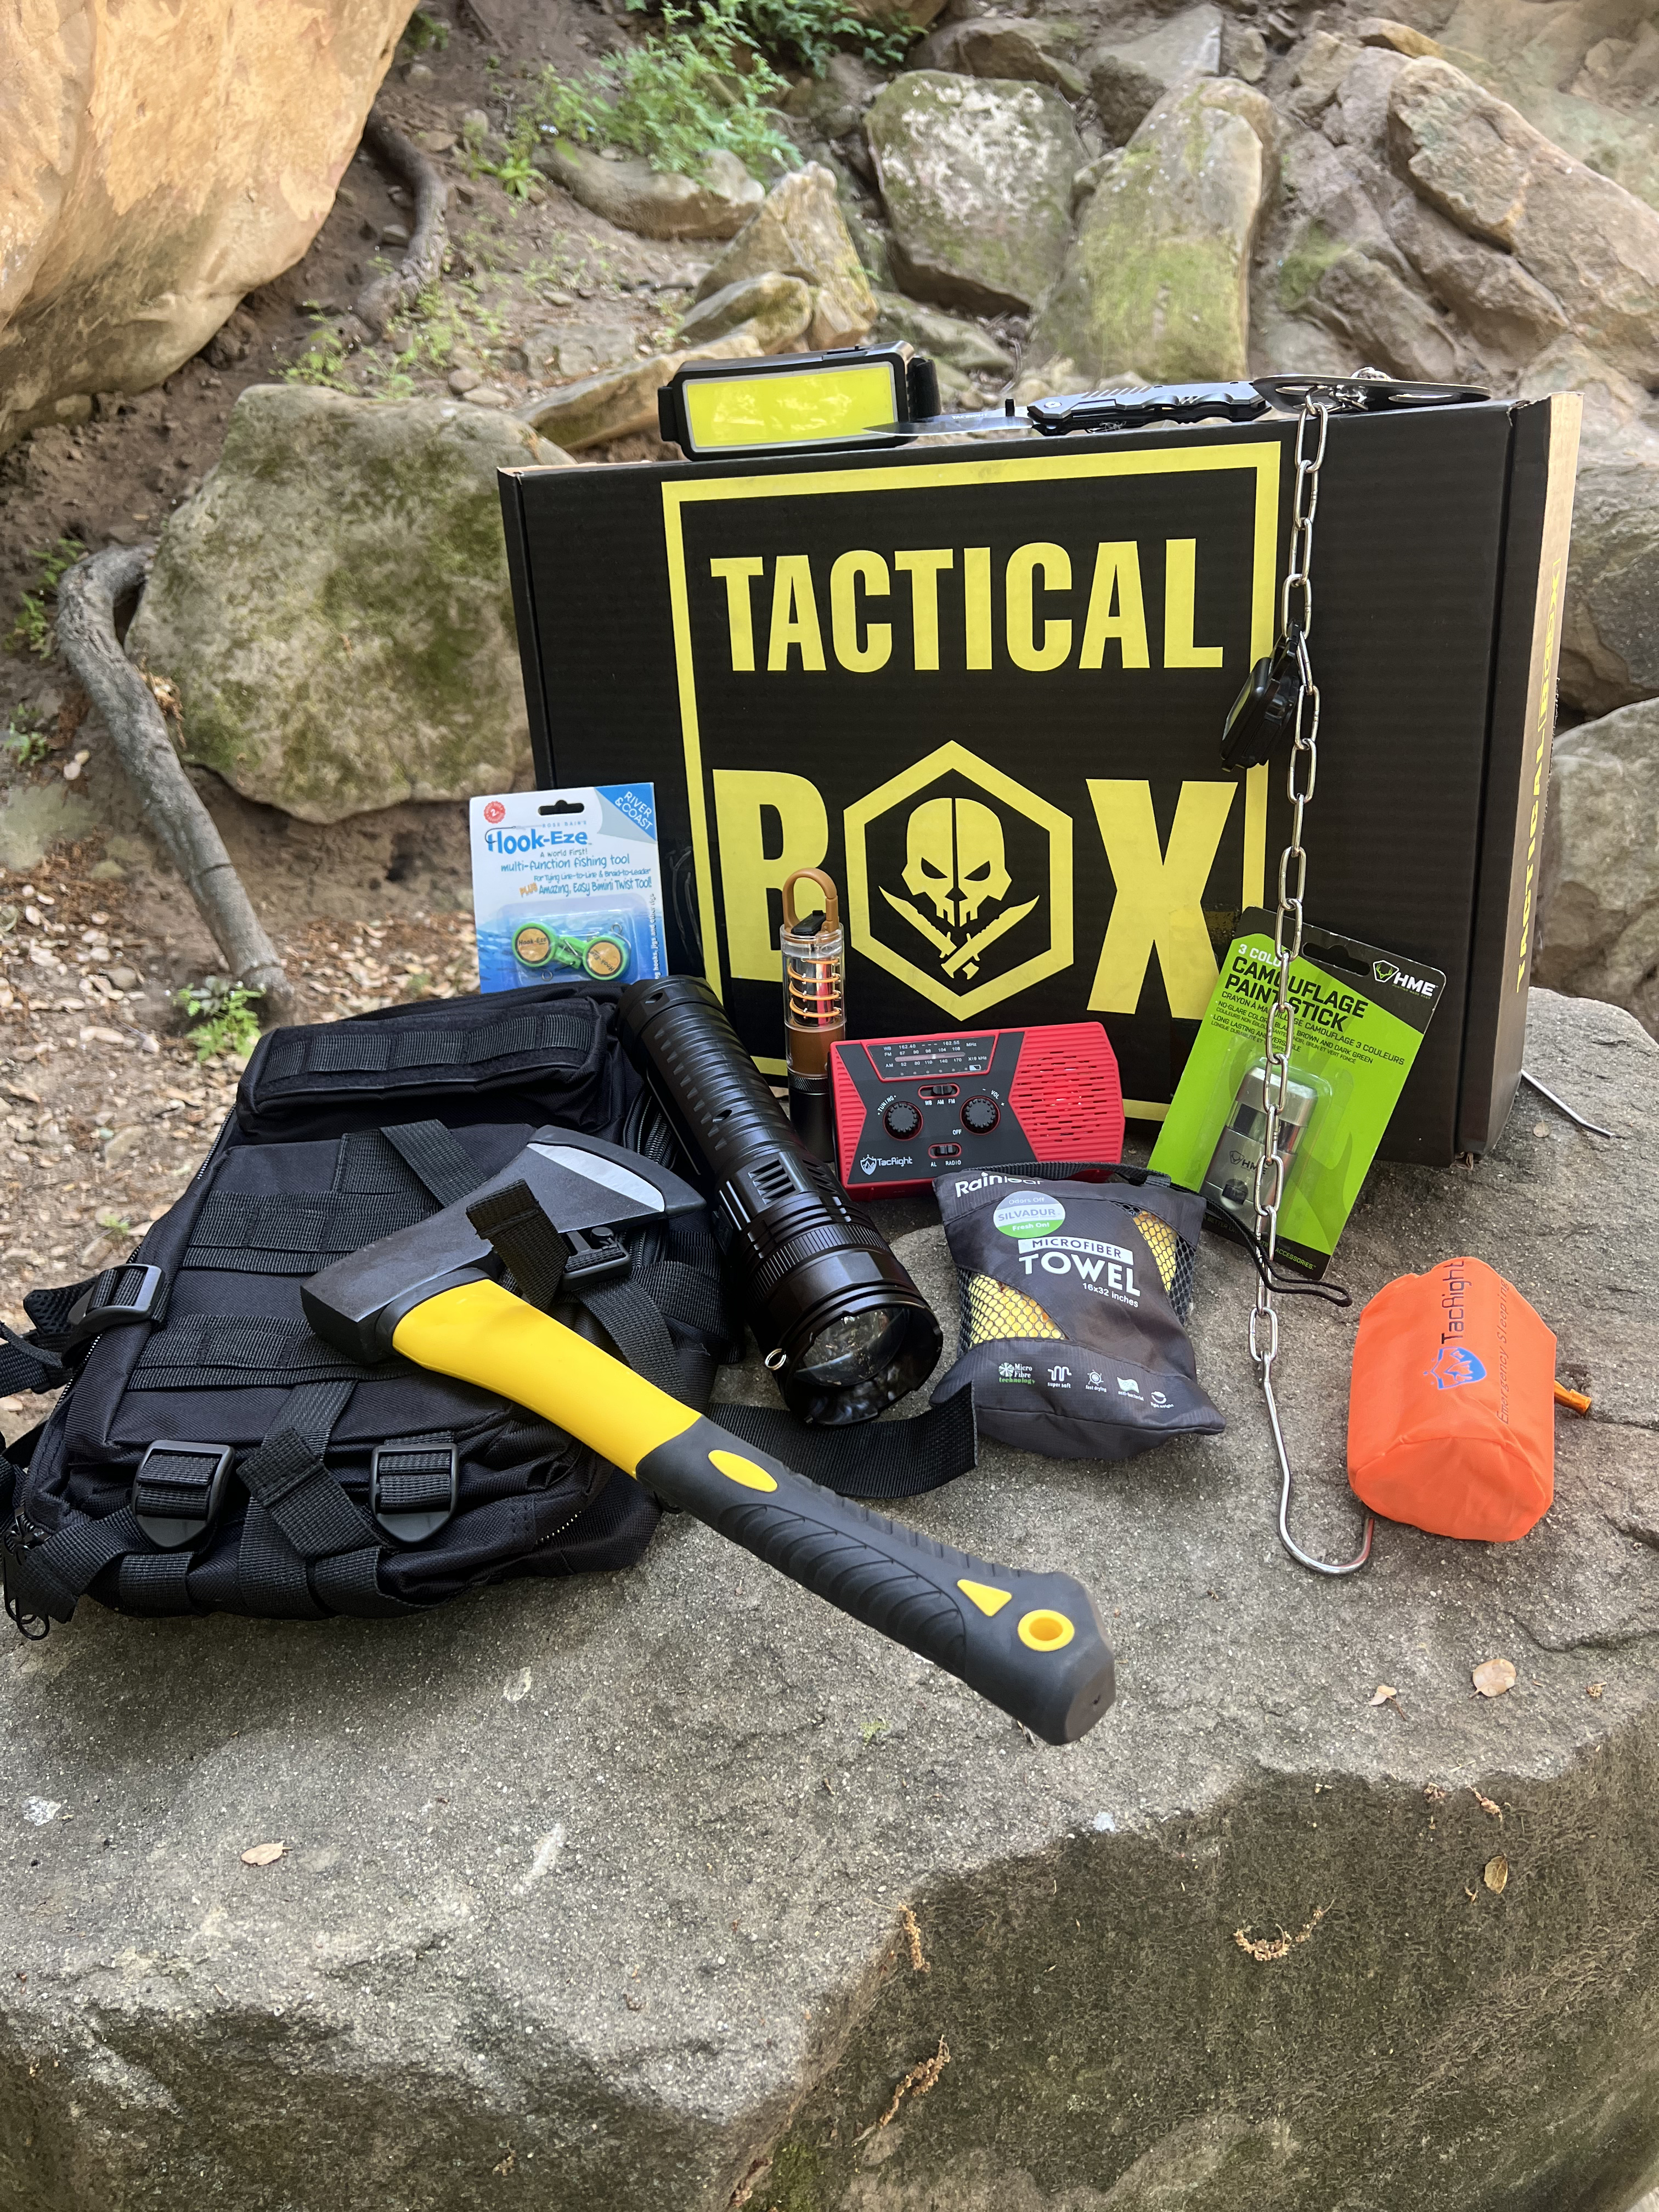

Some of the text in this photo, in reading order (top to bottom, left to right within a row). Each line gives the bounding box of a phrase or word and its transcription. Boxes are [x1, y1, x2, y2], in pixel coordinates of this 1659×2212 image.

[710, 538, 1223, 672] TACTICAL
[624, 791, 652, 818] RIVER
[487, 828, 588, 854] Hook-Eze
[501, 854, 630, 872] multi-function fishing tool
[1516, 726, 1545, 992] TACTICAL
[519, 876, 652, 898] PLUS Amazing, Easy Bimini Twist Tool!
[544, 874, 560, 884] Tying
[712, 740, 1239, 1021] BOX
[518, 937, 548, 946] Hook-Eze
[1238, 943, 1282, 967] 3 COLO
[1393, 972, 1436, 997] HME
[1211, 1020, 1230, 1031] LONGUE
[1213, 1014, 1230, 1025] LONG
[1230, 1020, 1255, 1035] LASTING
[1288, 996, 1349, 1032] STICK
[1216, 1007, 1241, 1019] COULEURS
[1306, 1041, 1319, 1049] BRUN
[1327, 1048, 1340, 1057] VERT
[1218, 1000, 1248, 1015] NO-GLARE
[1248, 1012, 1268, 1024] COLOR
[1296, 1030, 1319, 1043] BROWN
[1319, 1039, 1334, 1049] AND
[1334, 1045, 1352, 1056] DARK
[1352, 1051, 1373, 1064] GREEN
[1222, 991, 1251, 1007] CRAYON
[1250, 1001, 1256, 1009] À
[1256, 1005, 1304, 1026] MAUILLGE
[1305, 1022, 1356, 1046] CAMOUFLAGE
[1363, 1044, 1405, 1065] COULEURS
[877, 1095, 895, 1113] TUNING
[990, 1090, 999, 1099] VOL
[877, 1156, 913, 1167] TacRight
[998, 1209, 1056, 1221] SILVADUR
[1207, 1216, 1228, 1228] BETTER
[1012, 1222, 1034, 1232] Fresh
[1032, 1238, 1121, 1259] MICROFIBER
[1018, 1251, 1141, 1297] TOWEL
[1082, 1282, 1139, 1308] 16x32 inches
[1441, 1260, 1472, 1345] TacRight
[1496, 1277, 1511, 1425] Emergency Sleeping
[1014, 1363, 1032, 1372] Micro
[998, 1377, 1035, 1385] technology
